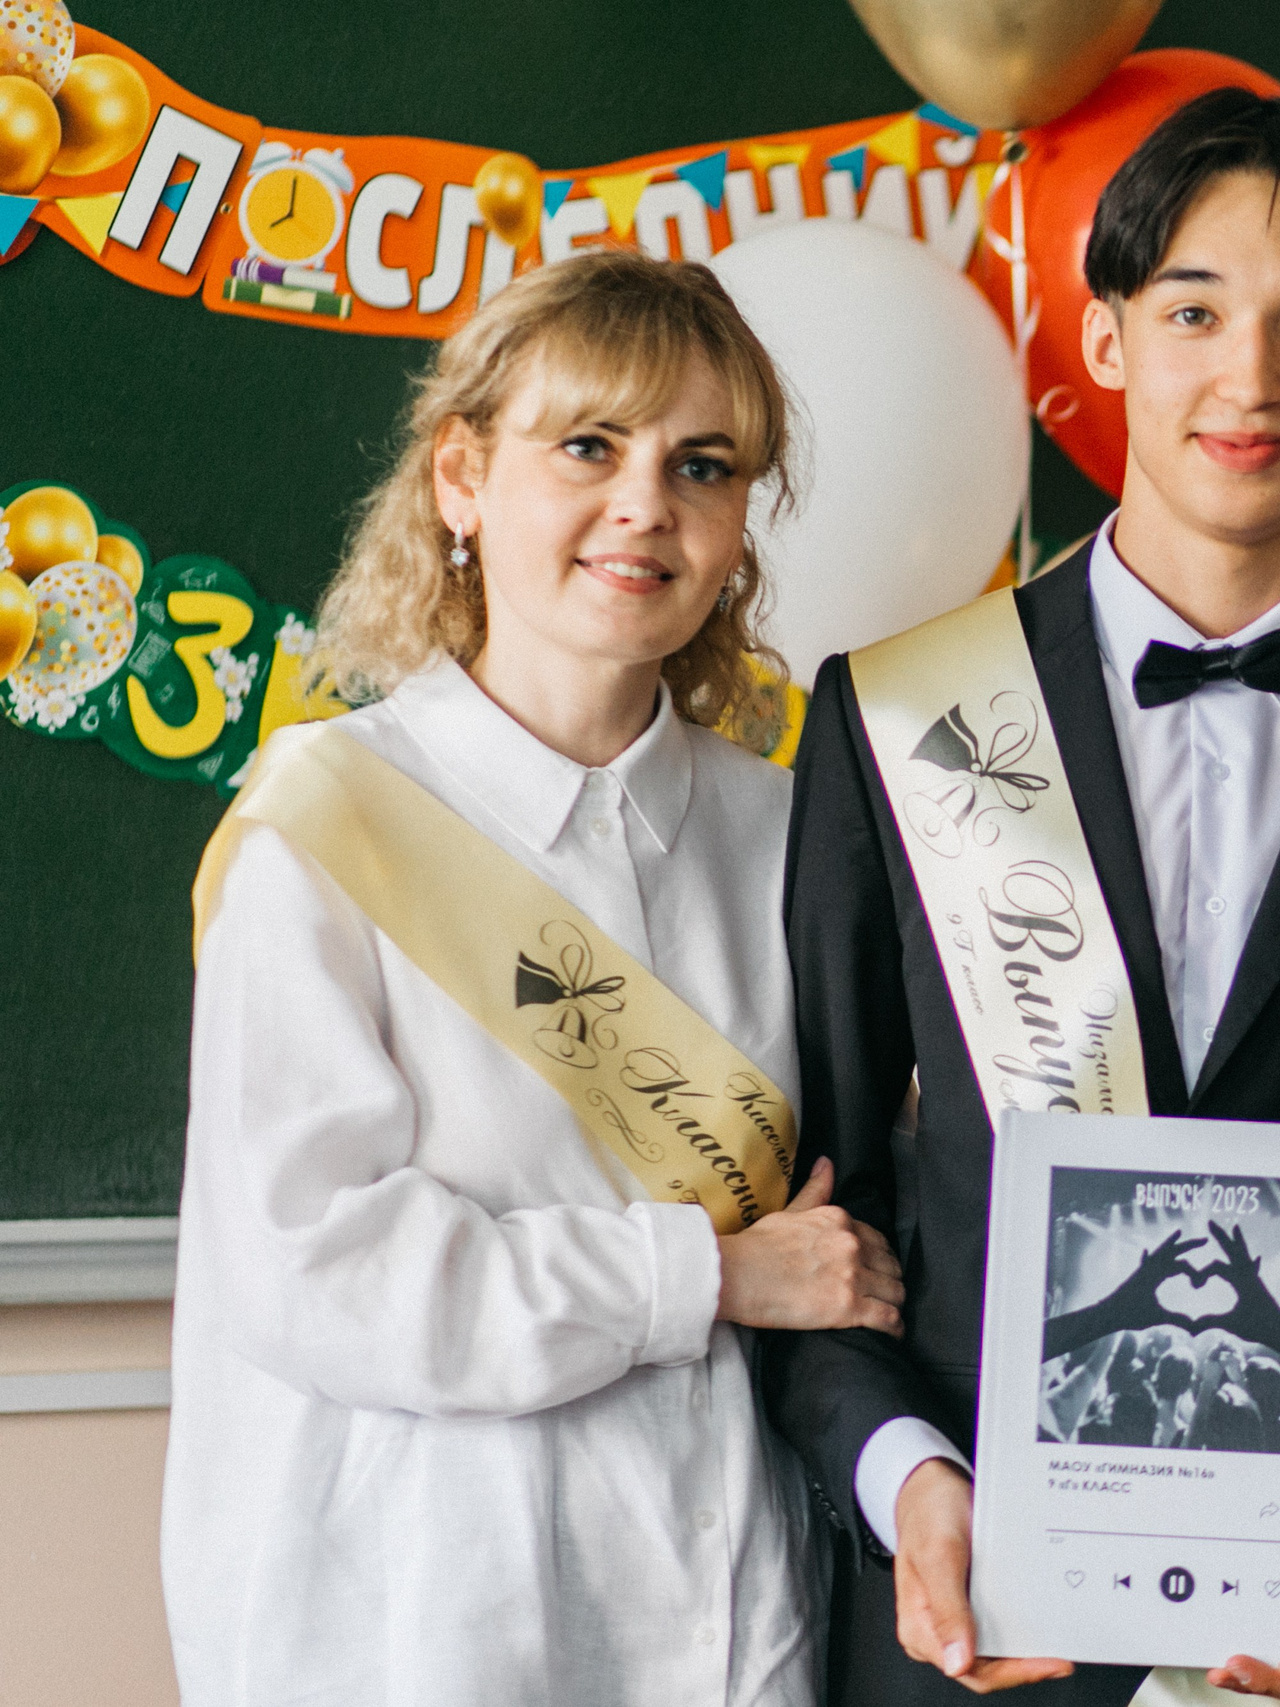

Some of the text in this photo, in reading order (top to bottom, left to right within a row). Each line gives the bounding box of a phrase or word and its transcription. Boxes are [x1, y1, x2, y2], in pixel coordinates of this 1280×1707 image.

[1135, 1182, 1260, 1214] ВЫПУСК 2023
[1050, 1460, 1092, 1472] МАОУ
[1048, 1478, 1055, 1489] 9
[1082, 1480, 1132, 1493] КЛАСС
